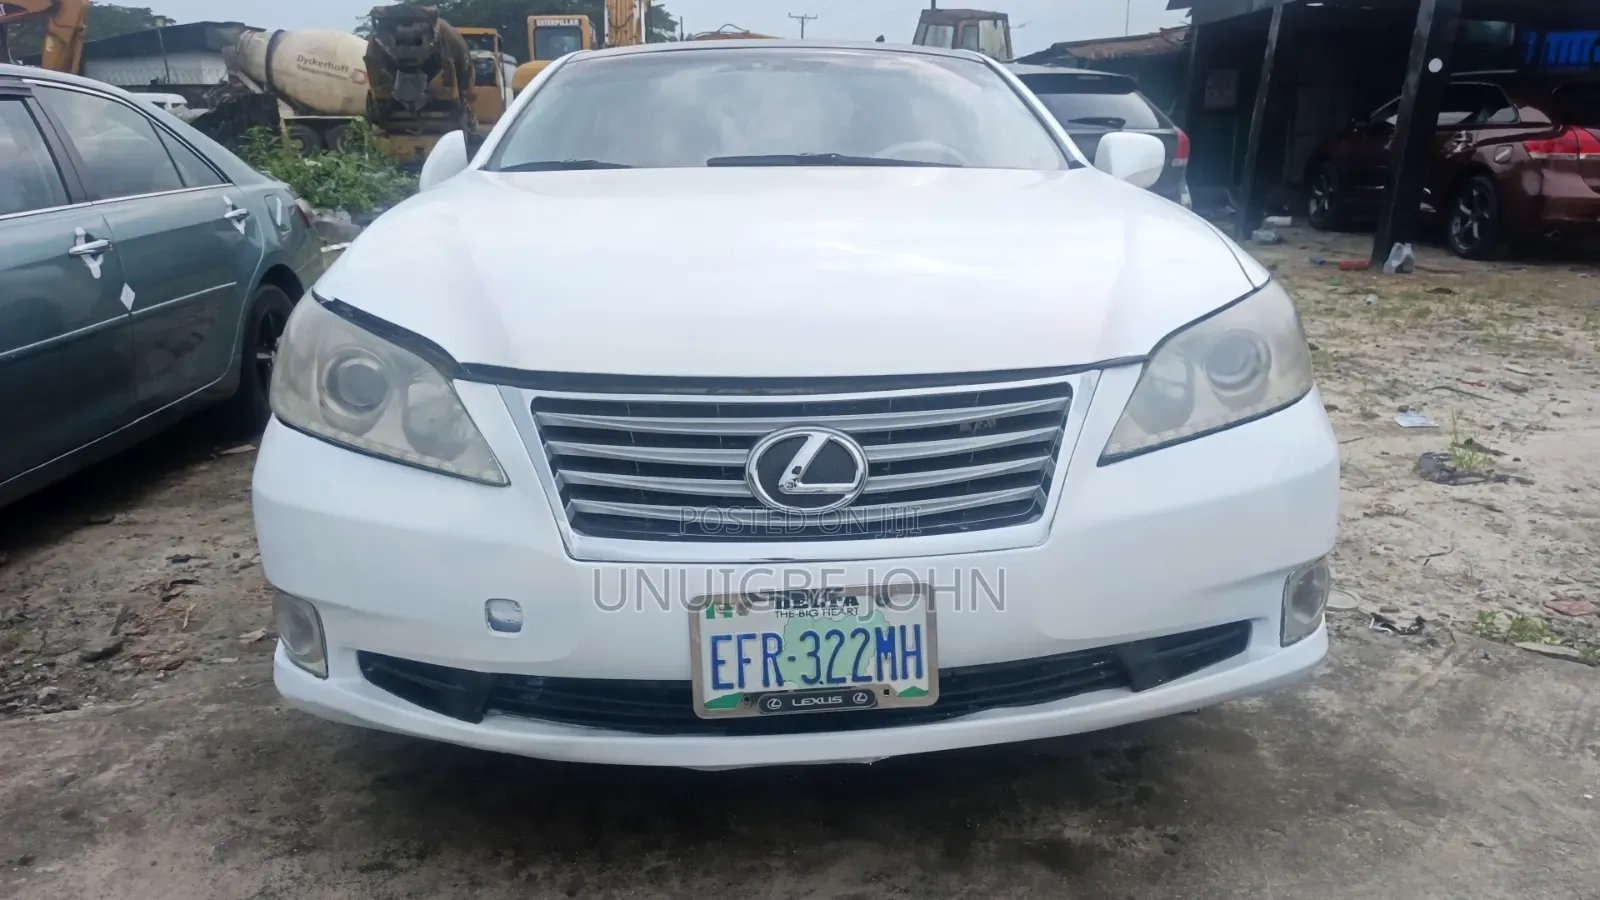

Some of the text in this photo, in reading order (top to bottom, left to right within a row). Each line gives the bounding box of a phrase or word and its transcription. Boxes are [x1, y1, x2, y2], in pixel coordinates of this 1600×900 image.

[775, 607, 859, 619] THE BIG HEART
[711, 624, 923, 690] EFR-322MH
[792, 695, 843, 707] LEXUS
